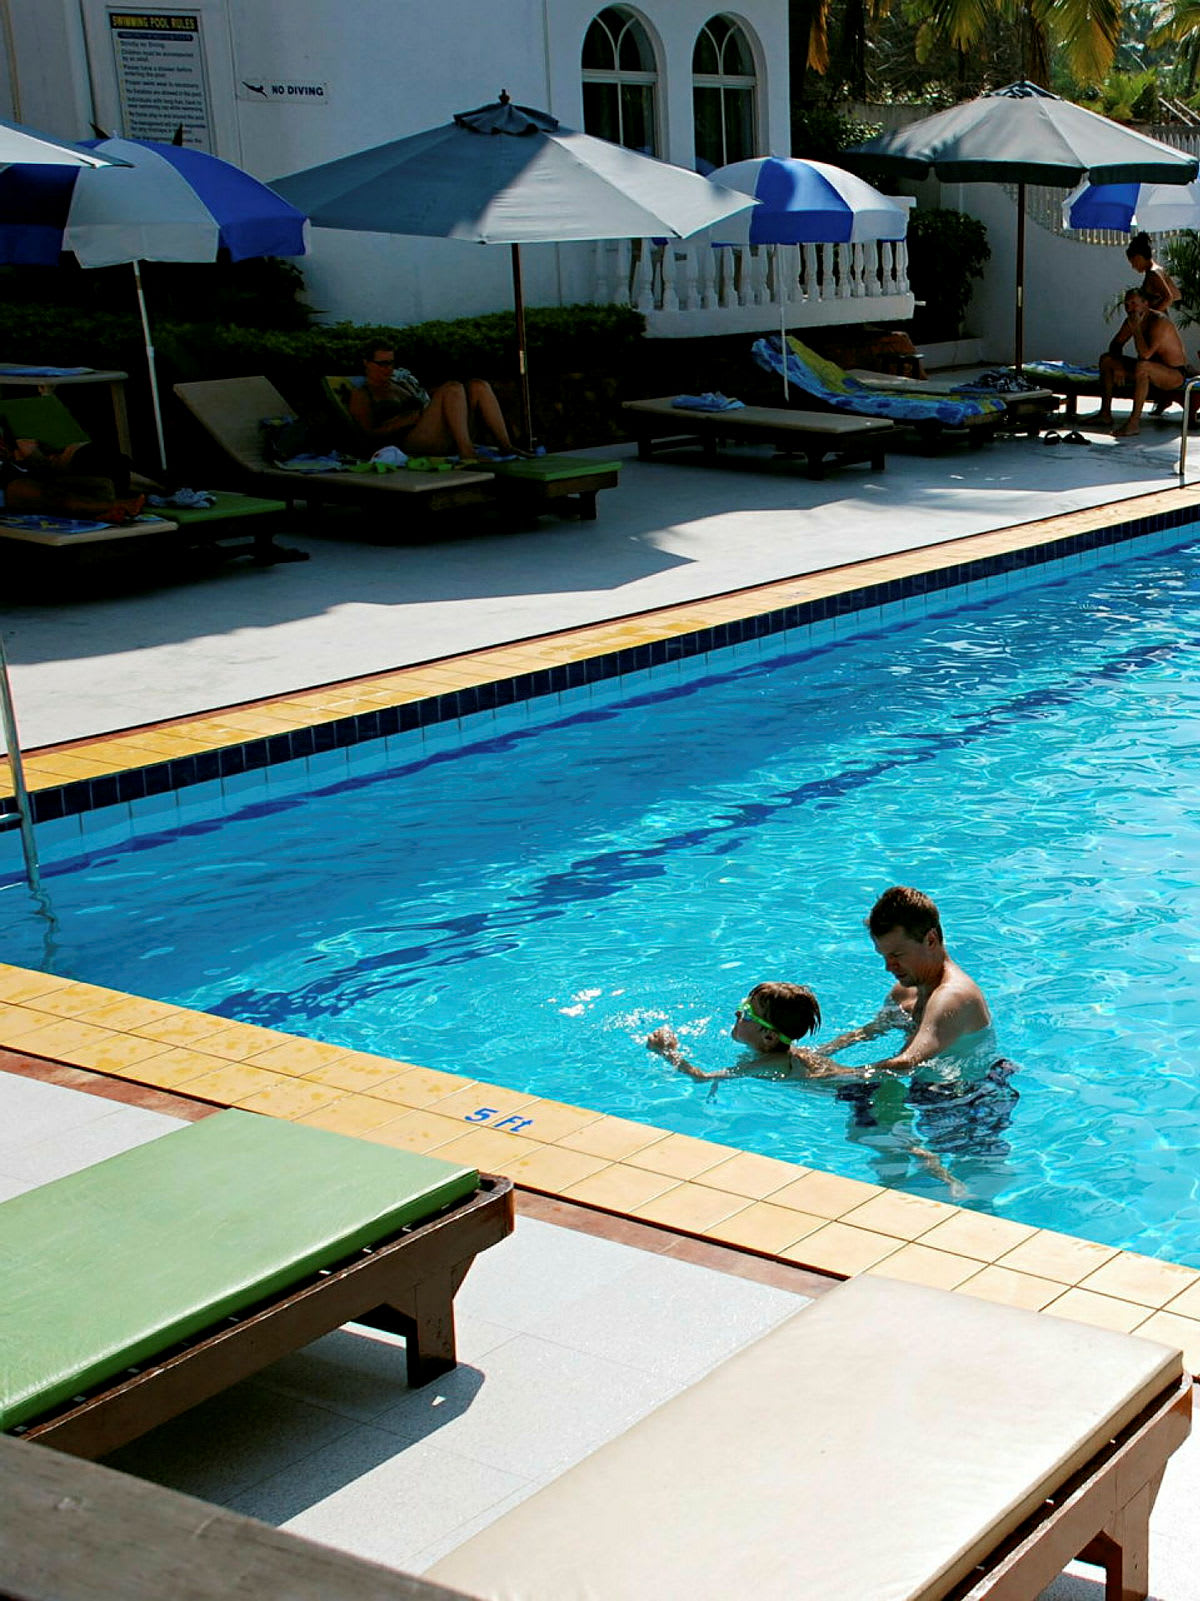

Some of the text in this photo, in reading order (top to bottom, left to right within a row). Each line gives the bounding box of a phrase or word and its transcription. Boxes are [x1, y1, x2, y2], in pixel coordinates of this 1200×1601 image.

[112, 15, 195, 29] SWIMMING POOL RULES
[272, 85, 324, 96] NO DIVING
[464, 1107, 499, 1122] 5
